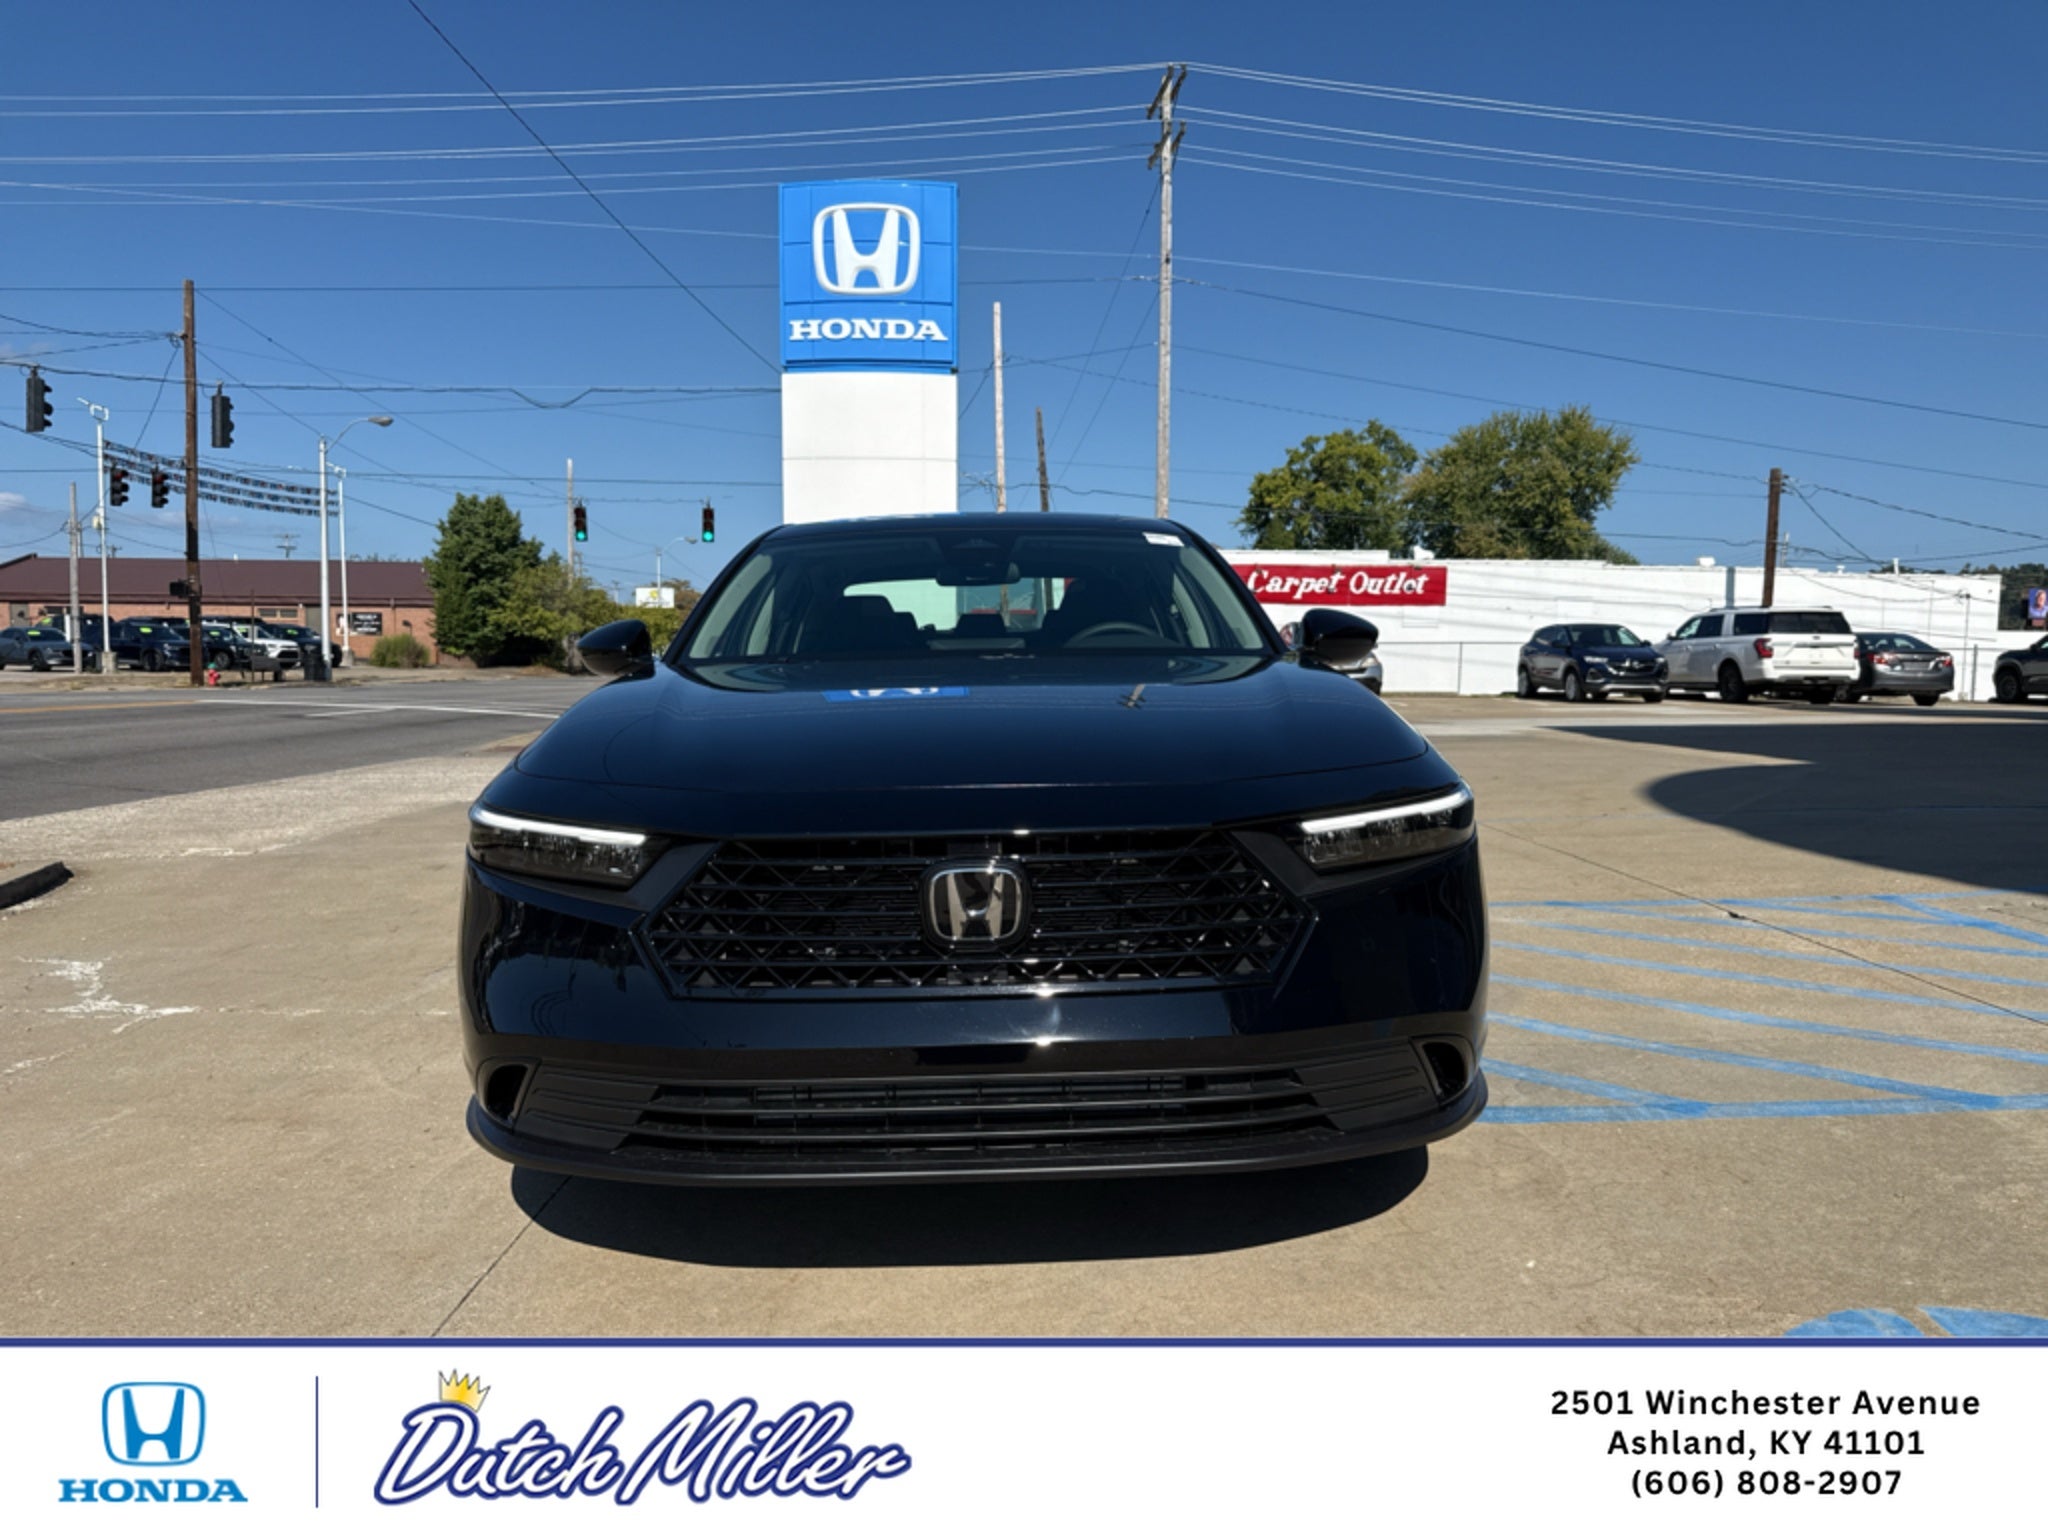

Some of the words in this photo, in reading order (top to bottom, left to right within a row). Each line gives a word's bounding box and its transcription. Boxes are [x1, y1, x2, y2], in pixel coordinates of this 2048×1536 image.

[789, 318, 948, 341] HONDA
[1247, 569, 1345, 600] Carpet
[1349, 571, 1429, 595] Outlet
